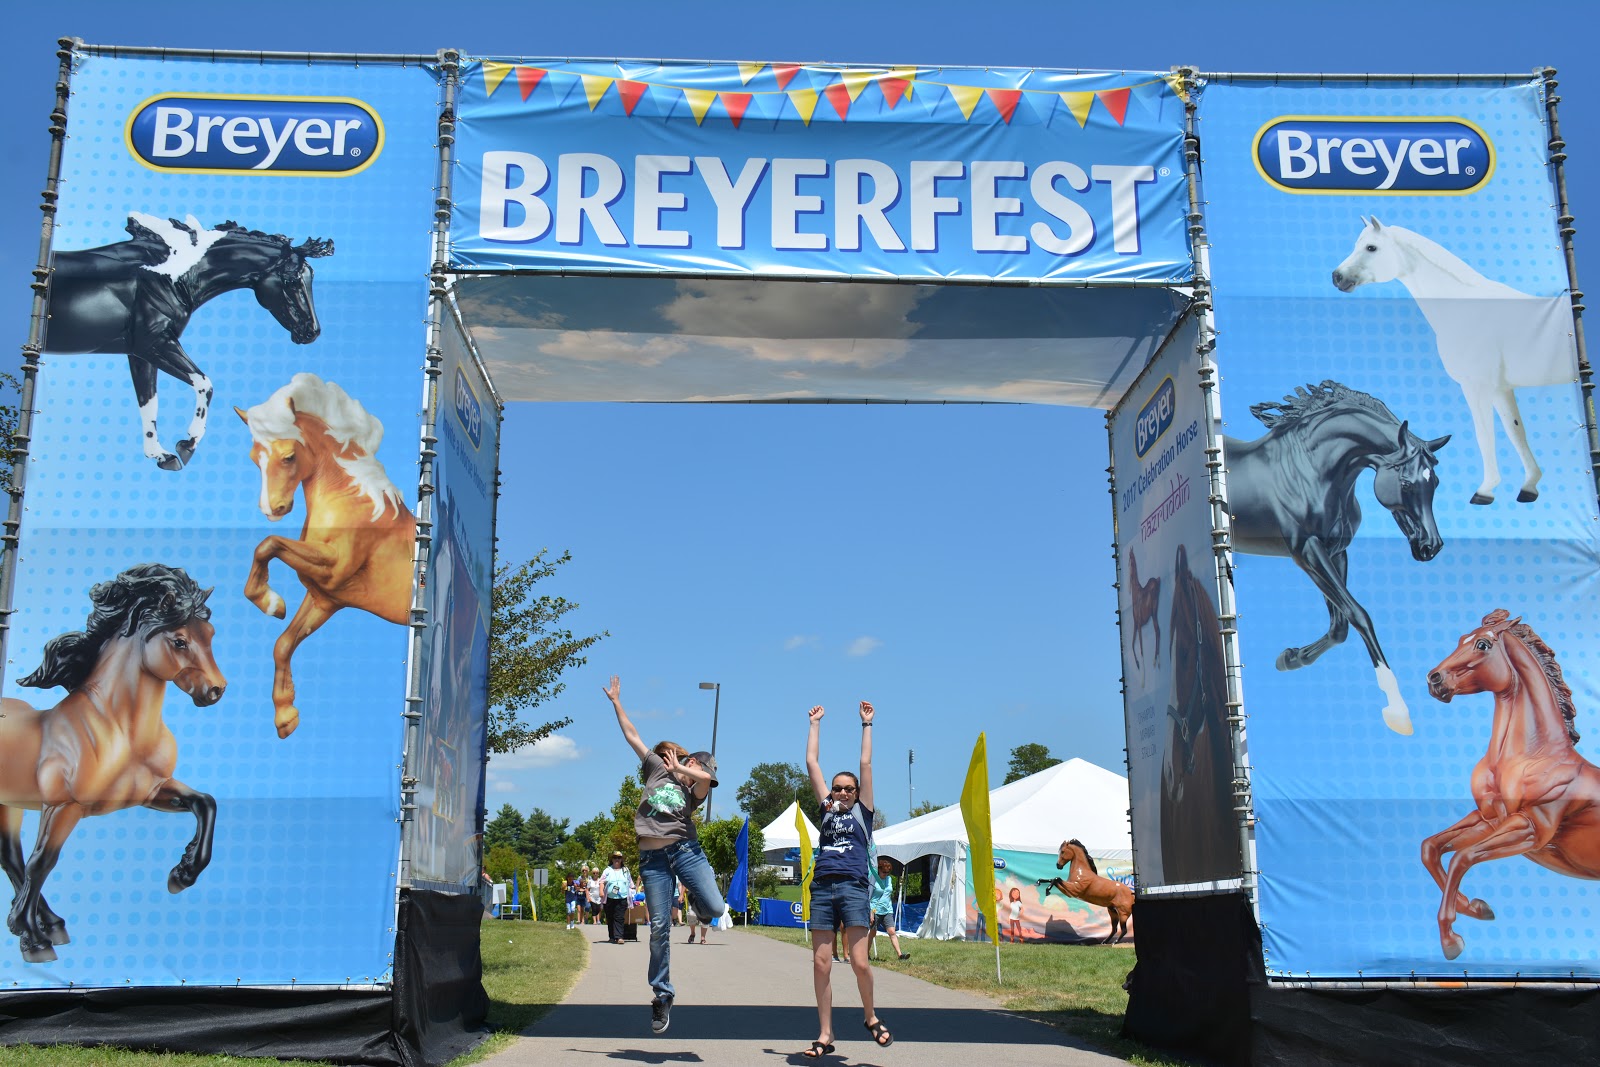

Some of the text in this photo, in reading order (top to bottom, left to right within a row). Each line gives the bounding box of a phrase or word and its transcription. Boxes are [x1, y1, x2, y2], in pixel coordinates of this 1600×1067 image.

[152, 106, 363, 170] Breyer
[1277, 129, 1472, 190] Breyer
[478, 150, 1157, 256] BREYERFEST
[456, 371, 480, 438] Breyer
[1137, 387, 1172, 453] Breyer
[1122, 420, 1198, 513] 2017 Celebration Horse
